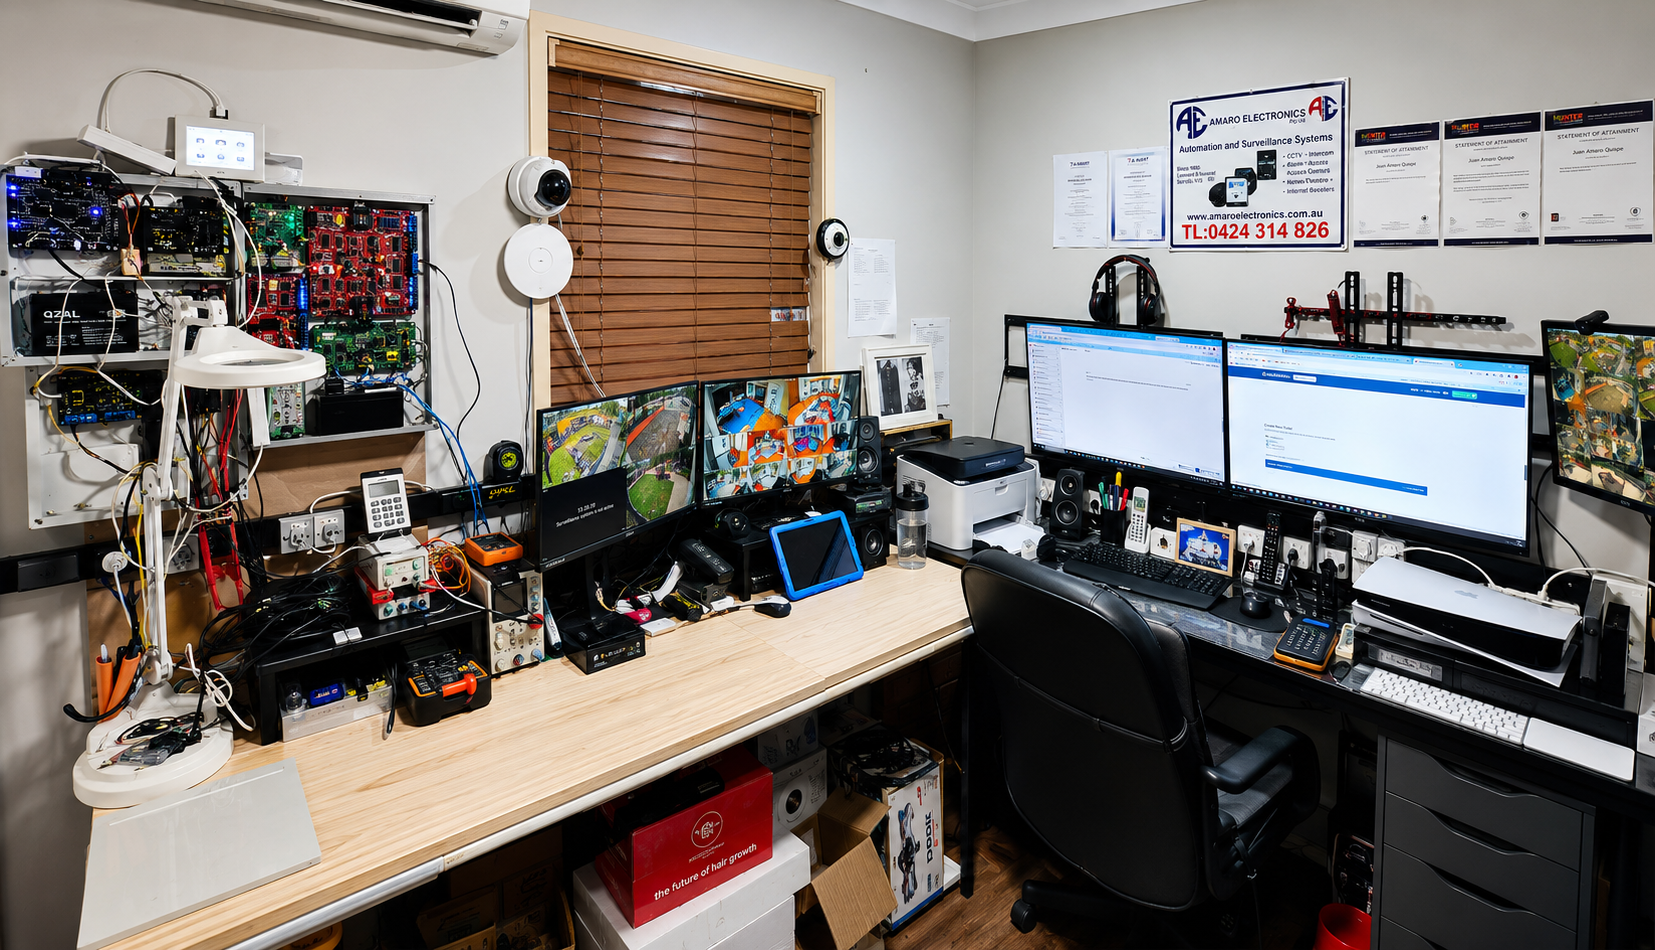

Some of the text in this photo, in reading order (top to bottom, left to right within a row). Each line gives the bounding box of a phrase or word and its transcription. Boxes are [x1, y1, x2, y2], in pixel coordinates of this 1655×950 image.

[1209, 109, 1306, 126] AMARO ELECTRONICS
[1601, 128, 1640, 136] ATTAINMENT
[1179, 134, 1333, 153] Automation and Surveillance Systems
[1187, 210, 1323, 221] www.amaroelectronics.com.au
[1182, 221, 1329, 240] TL:0424 314 826
[654, 887, 670, 901] the
[672, 872, 699, 891] future
[700, 865, 710, 877] of
[711, 858, 727, 872] hair
[728, 843, 757, 865] growth
